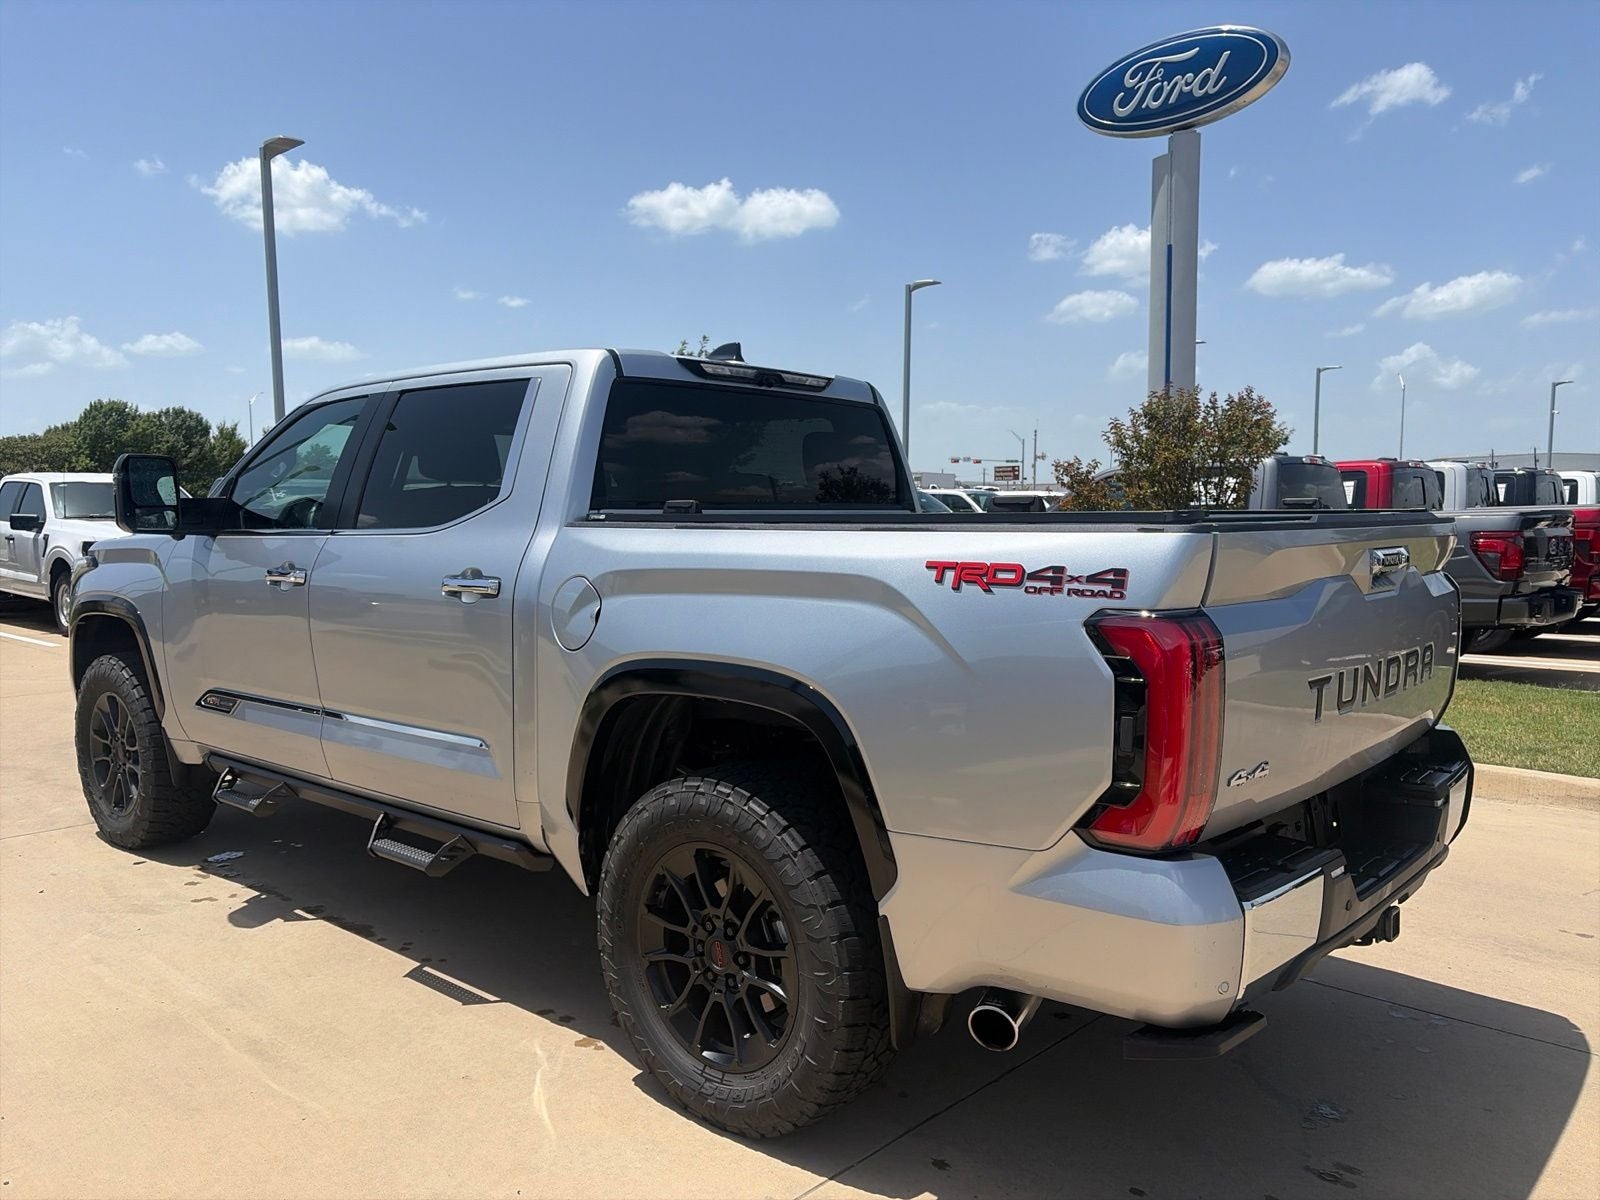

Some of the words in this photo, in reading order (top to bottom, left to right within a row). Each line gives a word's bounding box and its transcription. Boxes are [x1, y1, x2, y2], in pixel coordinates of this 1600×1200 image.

[1113, 47, 1231, 117] Ford
[925, 560, 1026, 595] TRD
[1024, 585, 1064, 598] OFF
[1066, 587, 1127, 600] ROAD
[1308, 641, 1435, 724] TUNDRA
